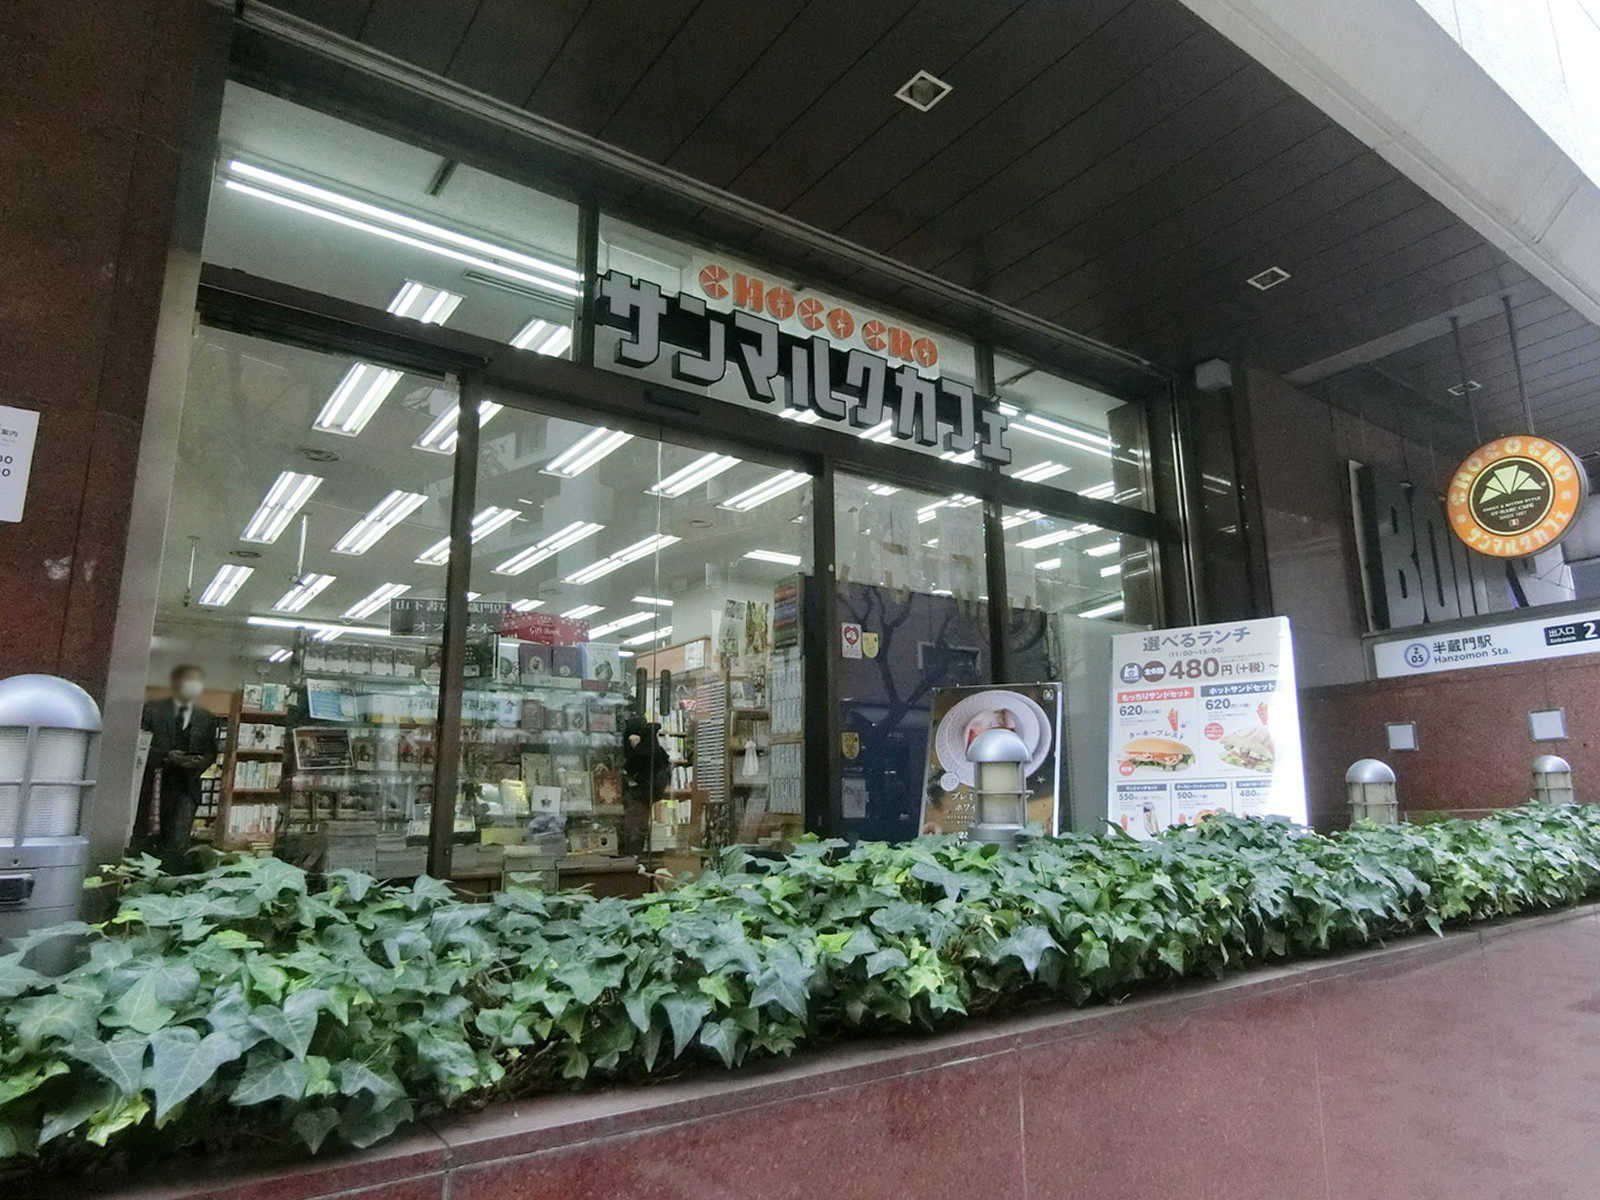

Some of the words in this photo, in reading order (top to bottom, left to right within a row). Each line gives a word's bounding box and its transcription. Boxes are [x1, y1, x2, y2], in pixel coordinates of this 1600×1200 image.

[699, 264, 854, 340] CHOCO
[862, 319, 939, 368] CRO
[598, 269, 1012, 466] サンマルクカフェ
[1142, 626, 1251, 652] 選べるランチ
[1548, 626, 1576, 638] 出入口
[1582, 622, 1599, 639] 2
[1432, 634, 1493, 655] 半蔵門駅
[1411, 654, 1424, 664] 05
[1433, 649, 1488, 665] Hanzomon
[1492, 646, 1512, 657] Sta.
